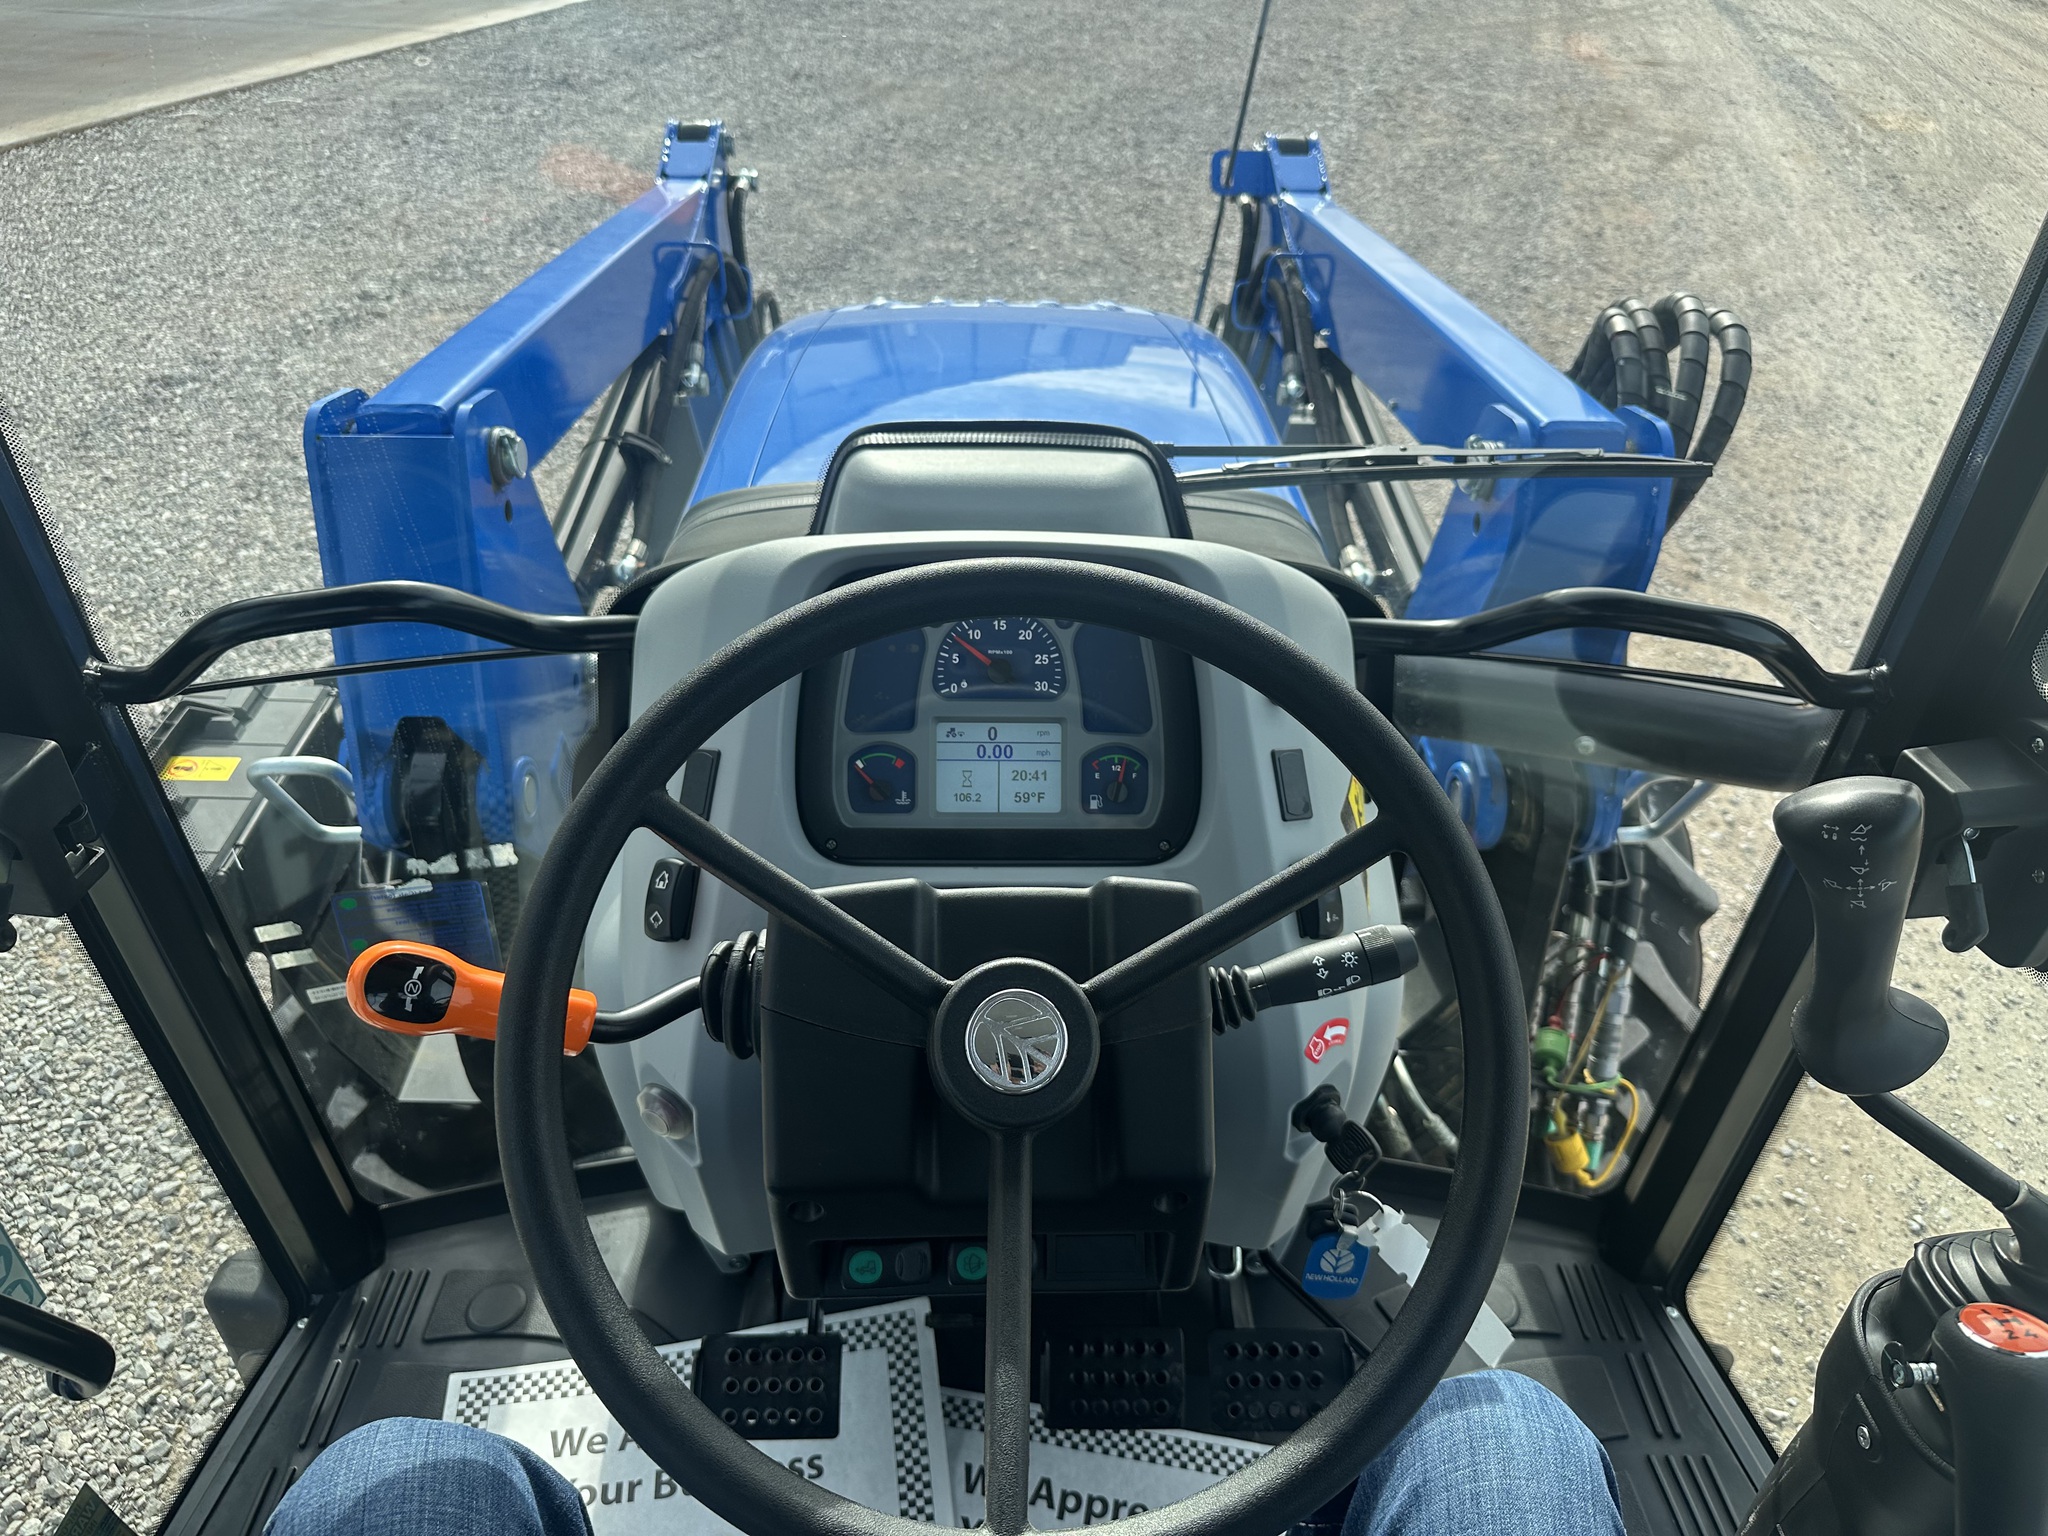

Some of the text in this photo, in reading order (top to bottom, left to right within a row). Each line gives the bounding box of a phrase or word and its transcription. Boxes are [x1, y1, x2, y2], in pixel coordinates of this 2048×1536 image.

[992, 620, 1007, 630] 15
[967, 629, 982, 640] 10
[1018, 630, 1033, 640] 20
[952, 653, 960, 663] 5
[1034, 654, 1049, 664] 25
[950, 683, 958, 693] 0
[1034, 681, 1048, 691] 30
[987, 726, 998, 741] 0
[976, 744, 1051, 759] 0.00 mph
[1011, 770, 1048, 782] 20:41
[953, 793, 982, 803] 106.2
[1013, 792, 1046, 803] 59°F
[1305, 1272, 1359, 1284] NEW HOLLAND
[550, 1426, 608, 1458] We
[571, 1476, 644, 1507] our
